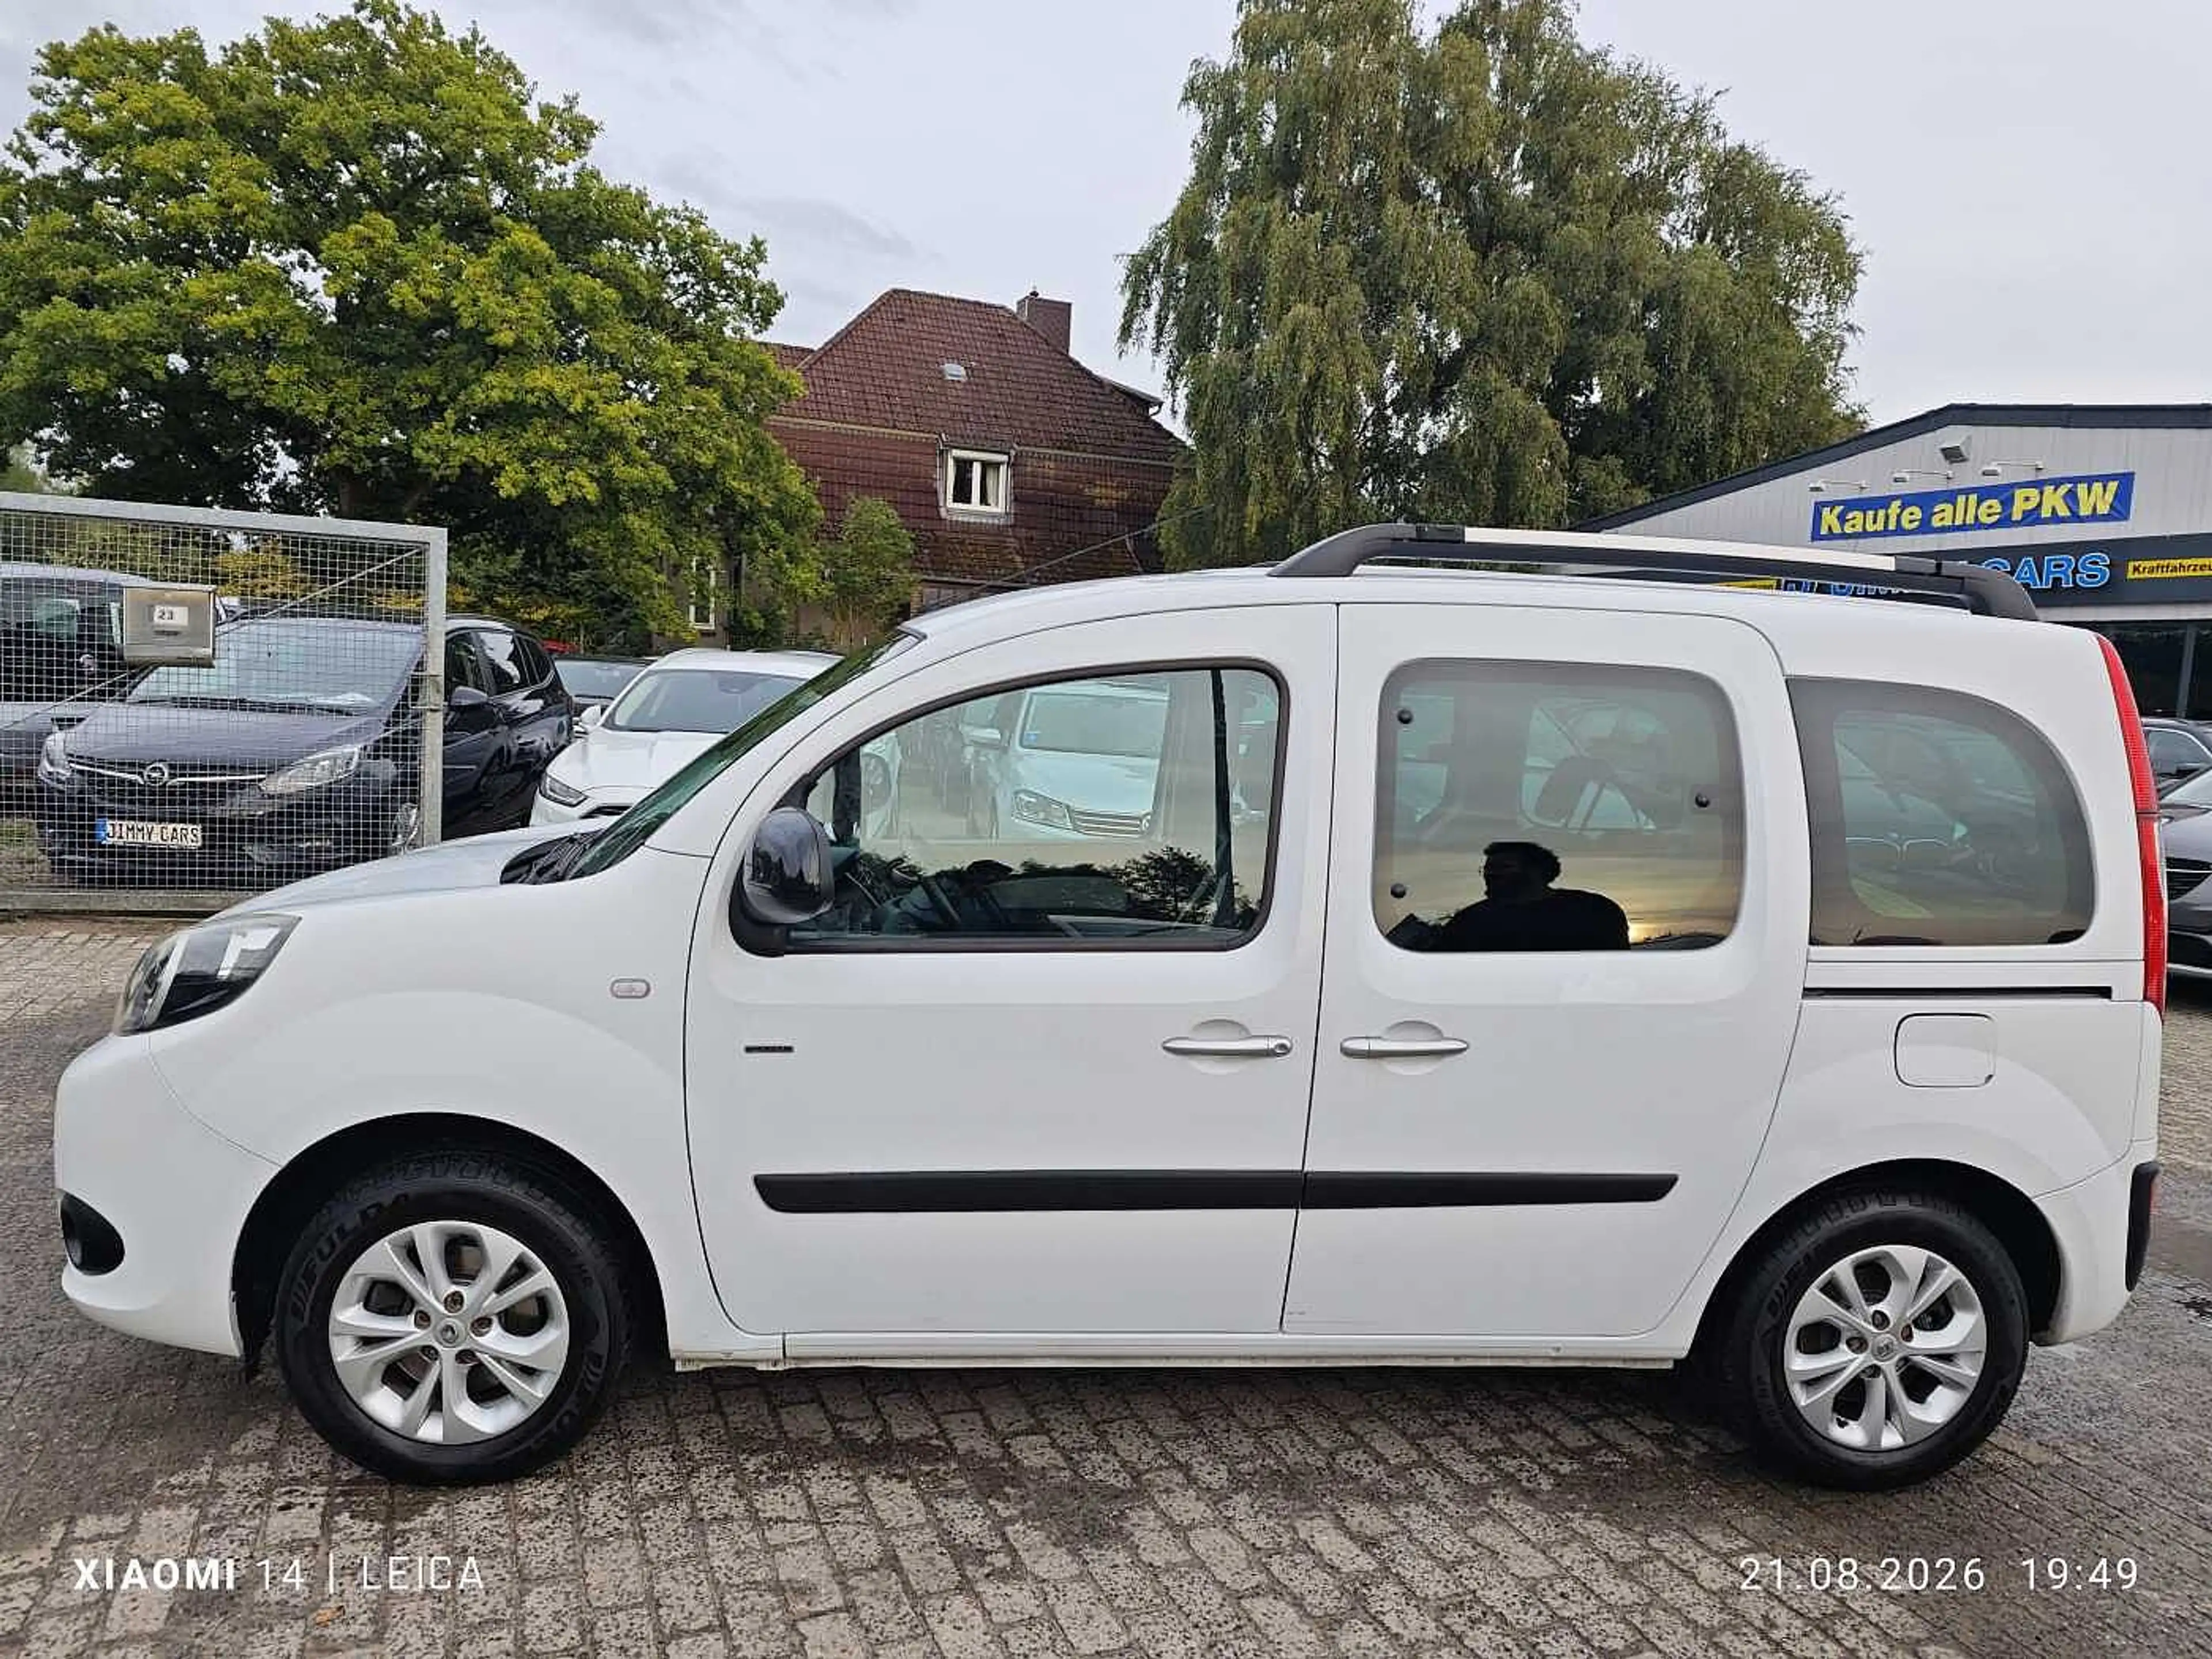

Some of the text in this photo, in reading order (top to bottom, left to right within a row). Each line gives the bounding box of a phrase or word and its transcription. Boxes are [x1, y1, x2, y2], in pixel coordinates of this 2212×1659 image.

[1820, 480, 2119, 535] Kaufe alle PKW
[107, 823, 199, 844] JIMMY CARS
